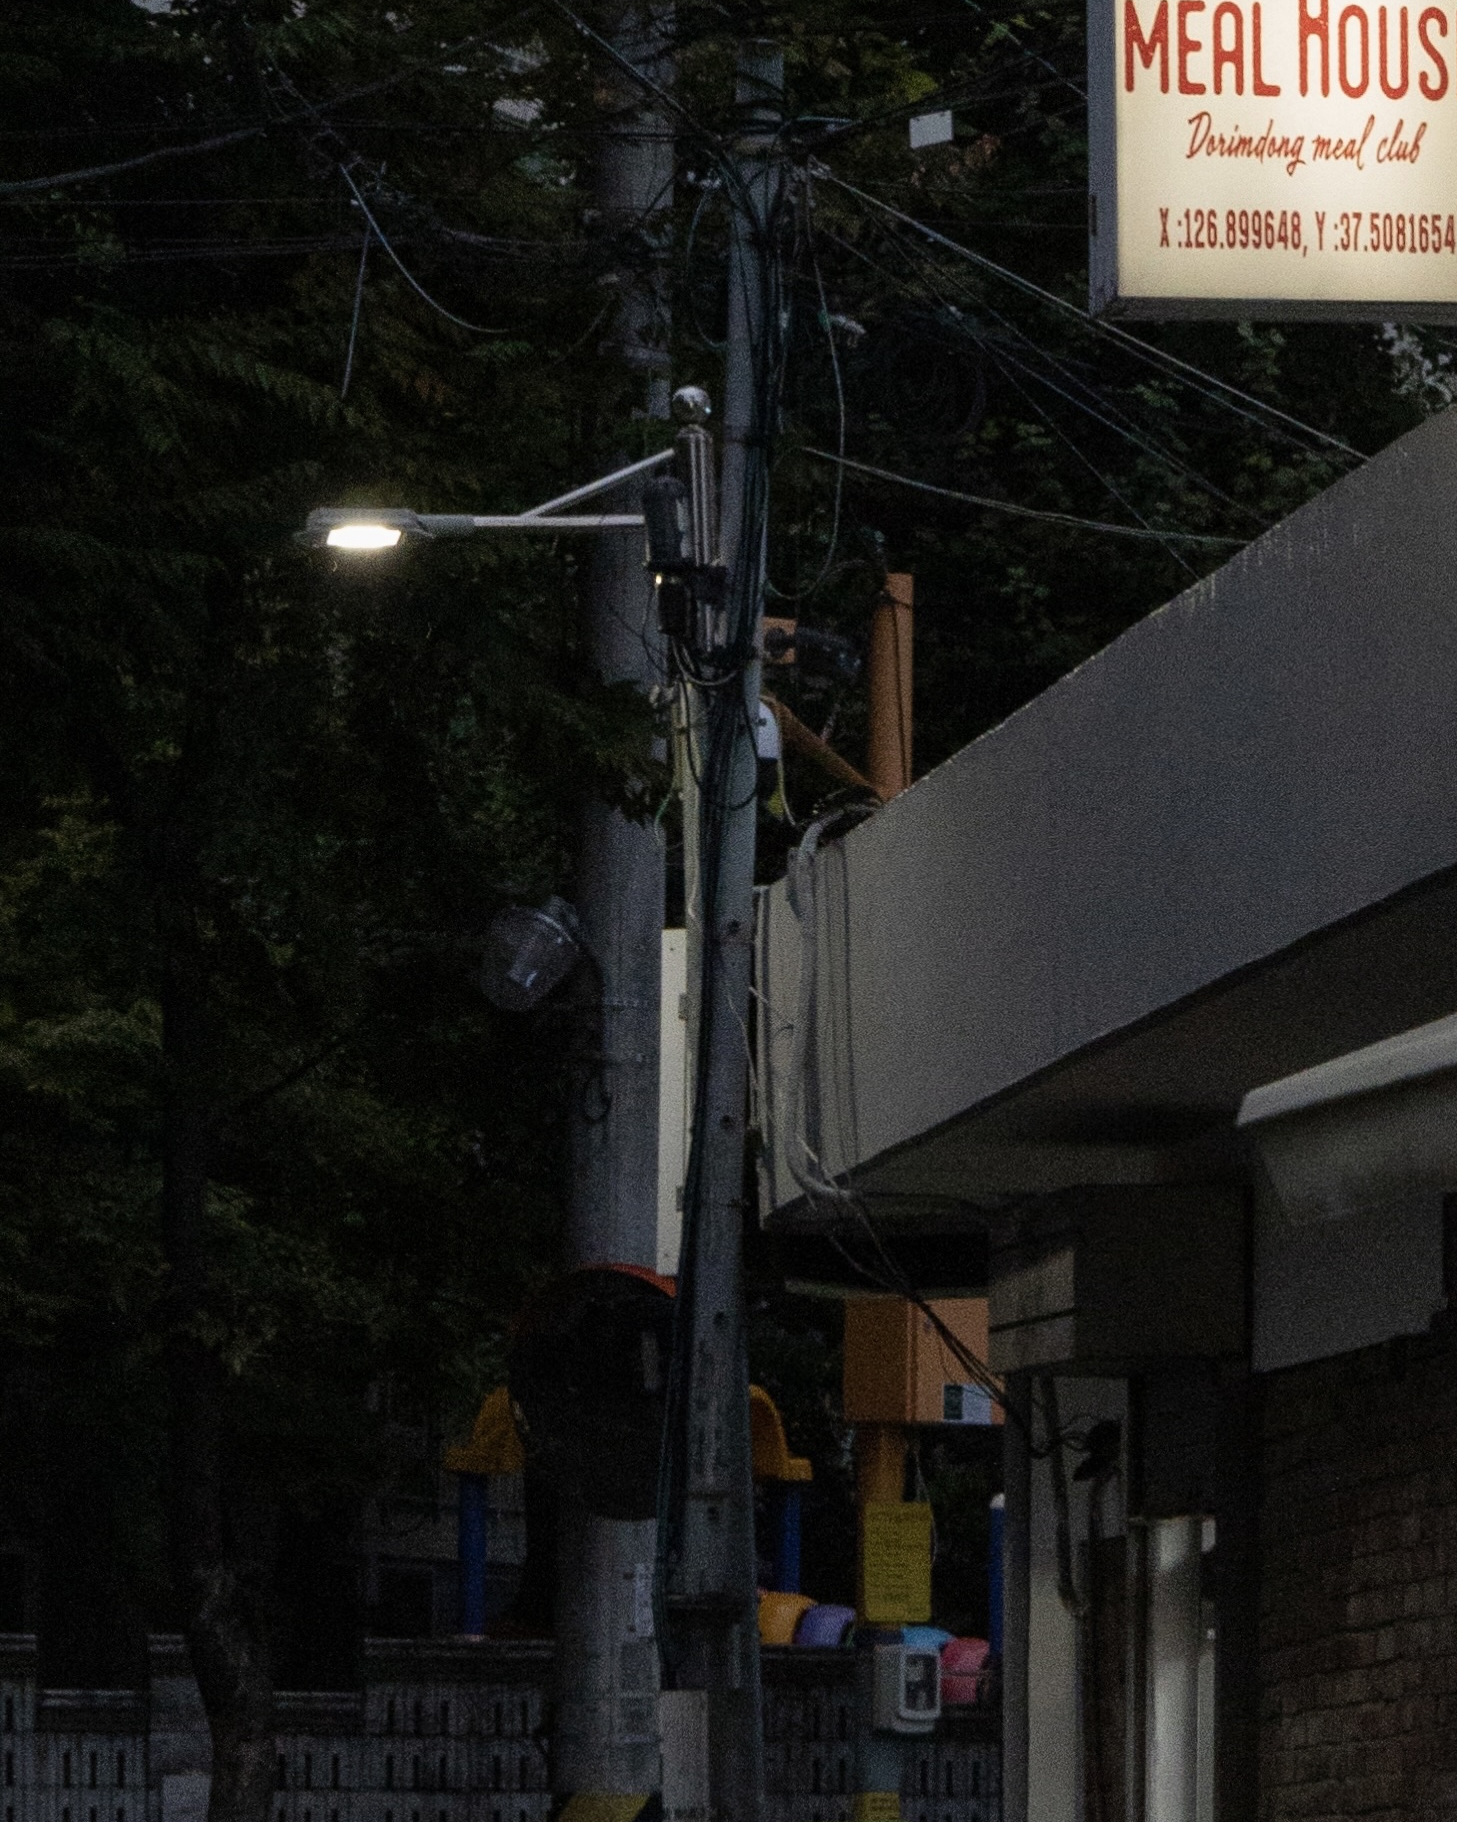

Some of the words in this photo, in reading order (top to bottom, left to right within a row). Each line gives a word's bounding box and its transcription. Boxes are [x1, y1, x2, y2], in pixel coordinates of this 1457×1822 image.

[1186, 111, 1306, 176] Dorimdong
[1311, 114, 1376, 171] meal
[1376, 118, 1428, 164] club
[1159, 207, 1170, 249] X
[1315, 211, 1326, 252] Y
